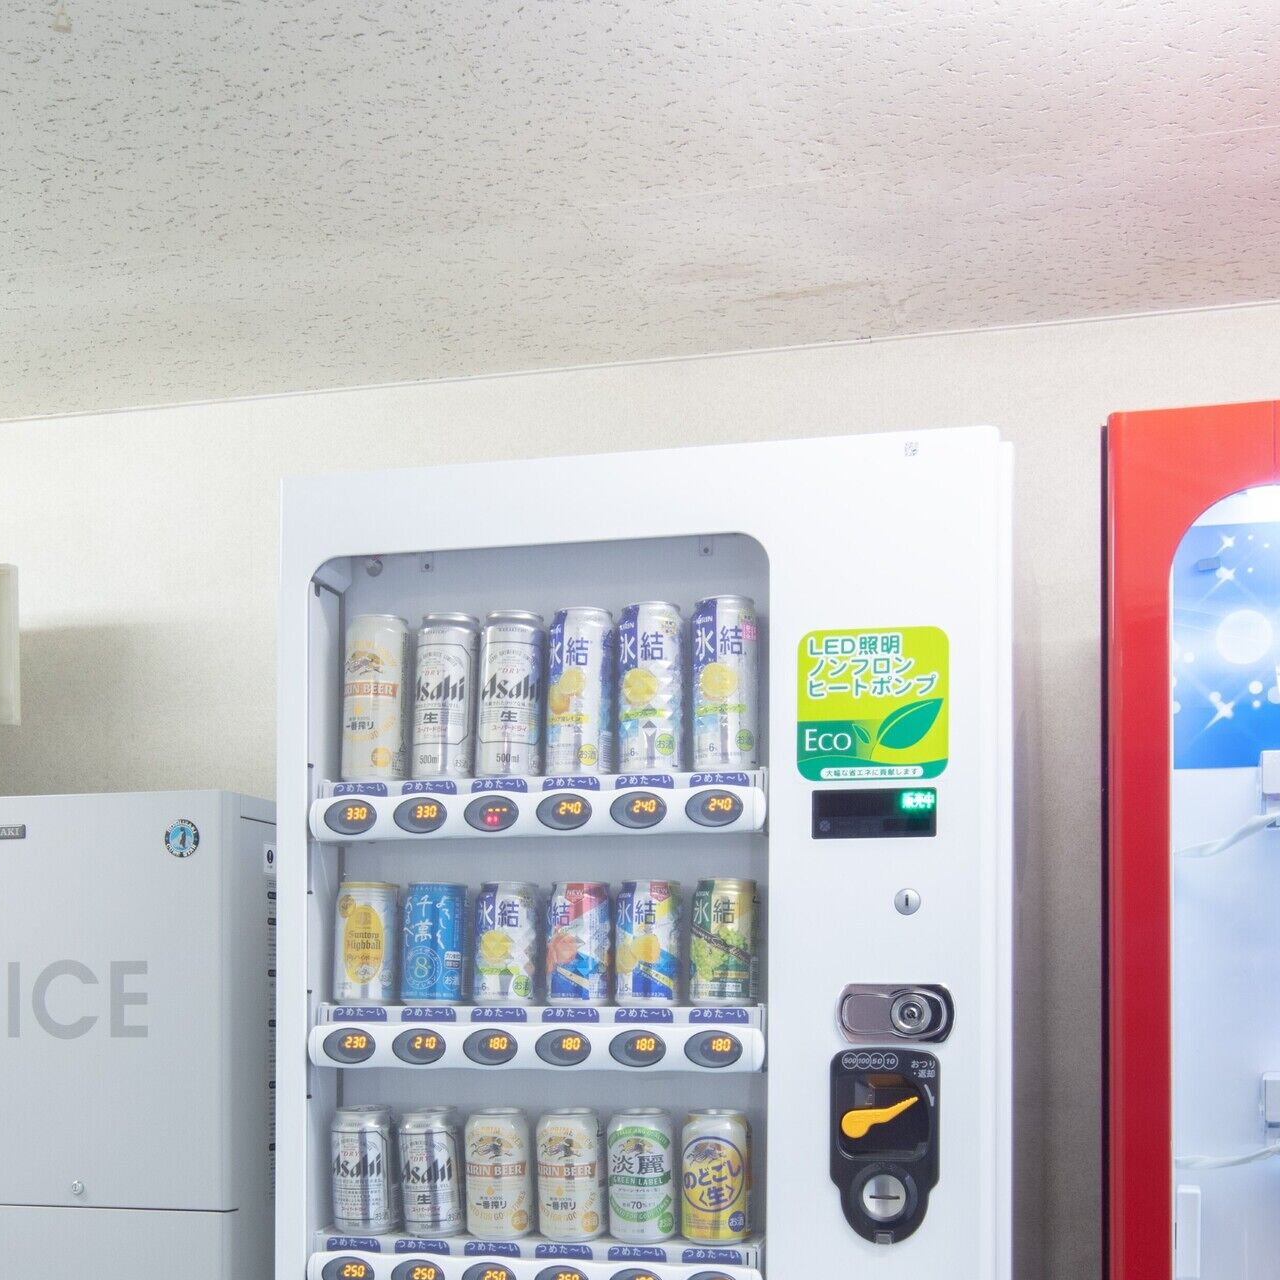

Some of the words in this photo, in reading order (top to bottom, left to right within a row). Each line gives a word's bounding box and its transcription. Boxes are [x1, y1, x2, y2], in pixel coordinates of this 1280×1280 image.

[808, 634, 902, 656] LED照明
[808, 657, 913, 677] ノンフロン
[481, 673, 541, 701] Asahi
[808, 674, 937, 698] ヒートポンプ
[500, 710, 518, 723] 生
[346, 806, 367, 821] 330
[416, 805, 437, 819] 330
[559, 801, 582, 815] 240
[479, 900, 520, 930] 氷結
[694, 899, 736, 926] 氷結
[7, 958, 149, 1040] ICE
[345, 1035, 367, 1049] 230
[414, 1036, 436, 1049] 210
[489, 1036, 507, 1050] 180
[635, 1037, 655, 1051] 180
[910, 1060, 936, 1069] おつり
[493, 1164, 522, 1177] BEER
[563, 1164, 592, 1177] BEER
[611, 1154, 665, 1175] 淡麗
[683, 1159, 741, 1190] のどごし
[546, 1200, 577, 1211] 一番搾り
[729, 1217, 746, 1227] お酒
[343, 1264, 365, 1278] 250
